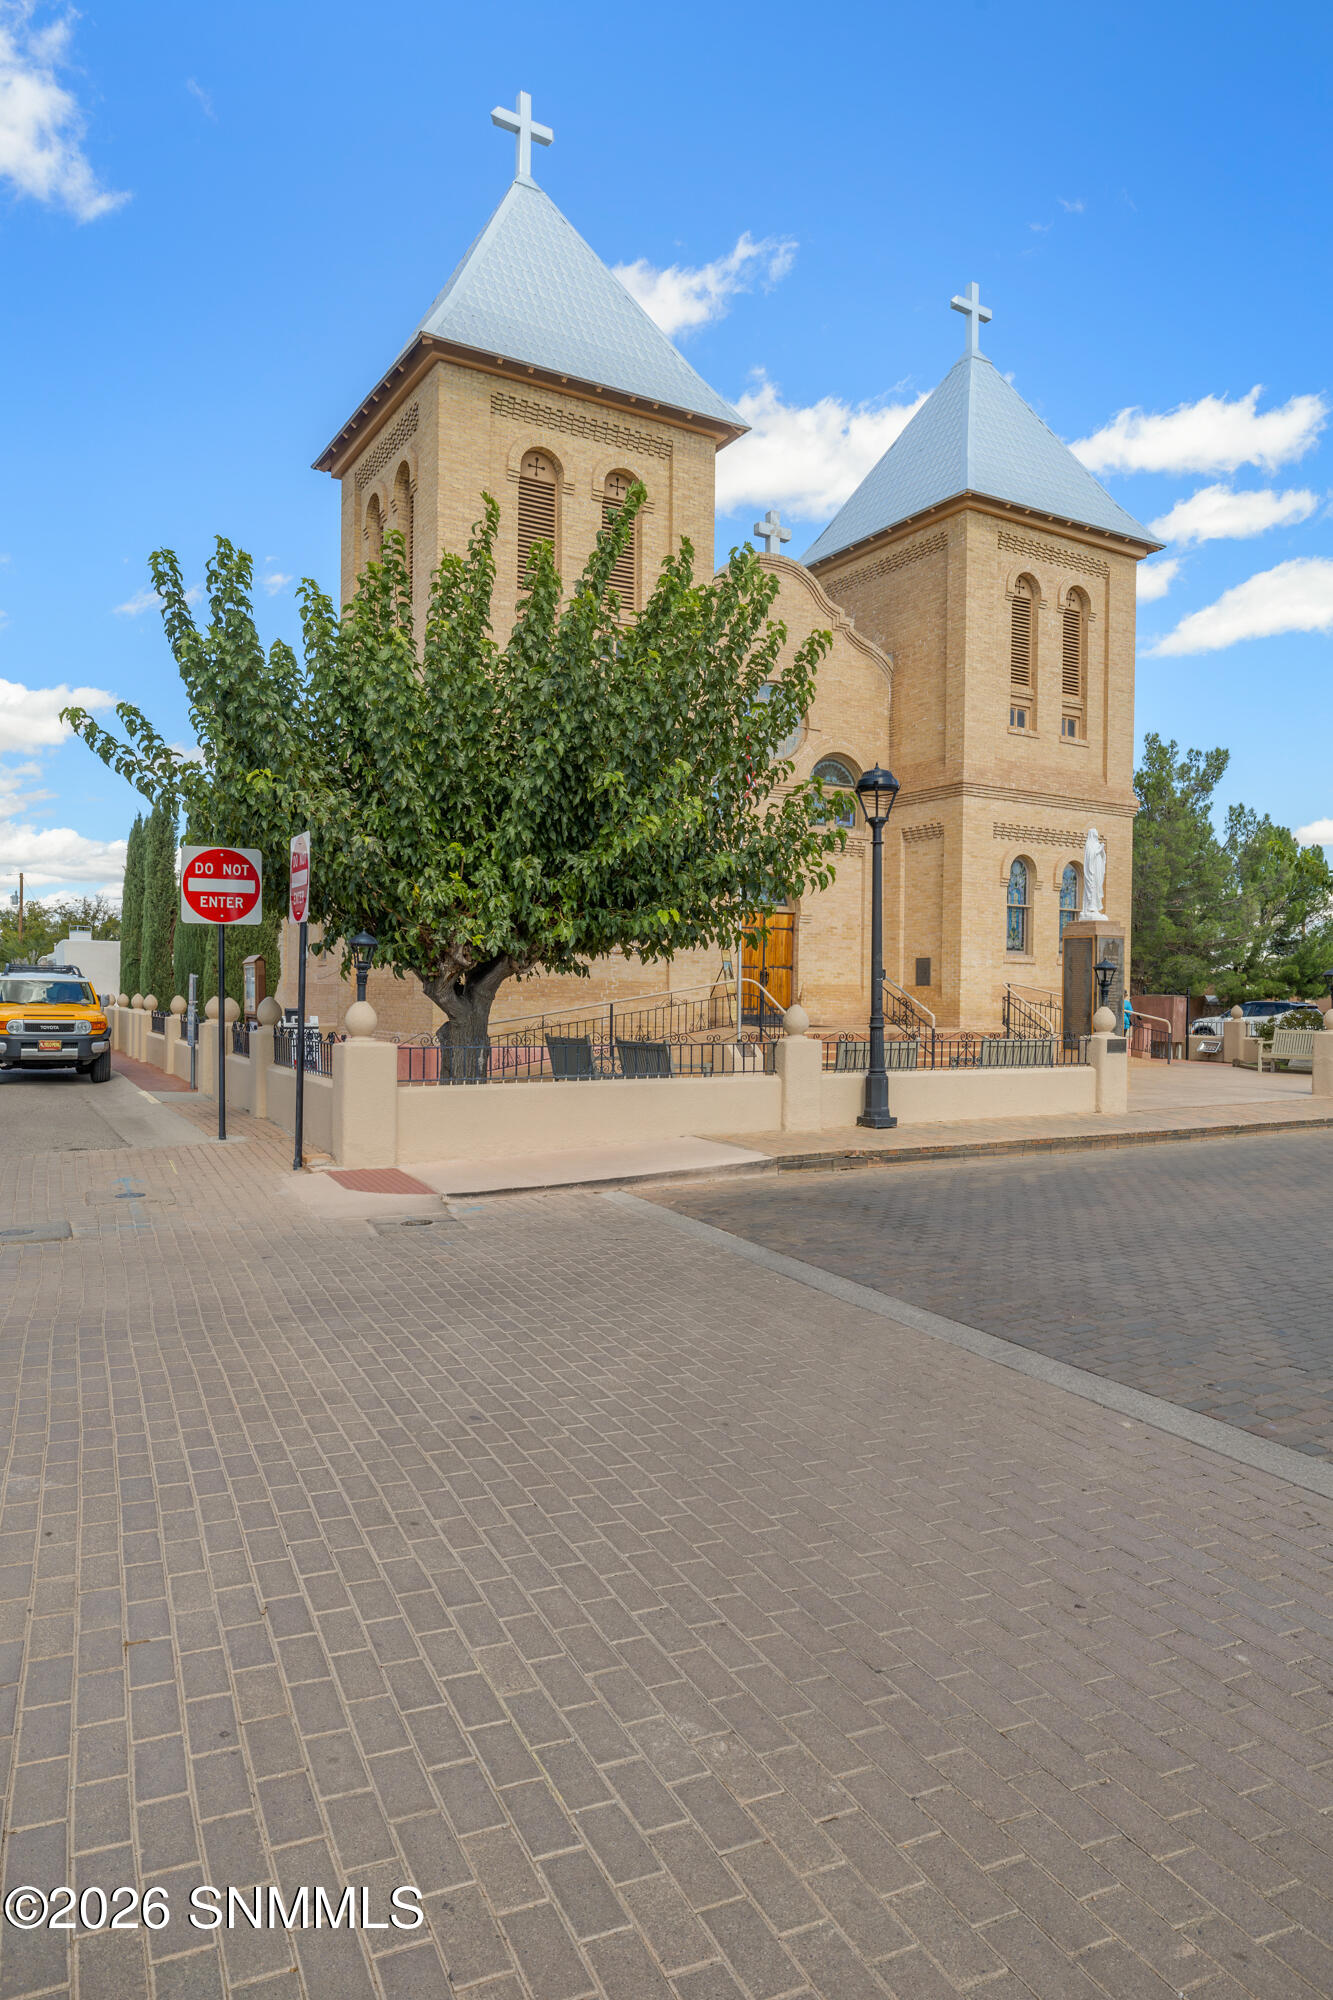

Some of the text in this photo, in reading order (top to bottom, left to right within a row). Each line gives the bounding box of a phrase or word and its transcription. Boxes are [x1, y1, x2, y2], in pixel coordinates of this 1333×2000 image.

[195, 862, 249, 876] DO NOT
[200, 896, 243, 909] ENTER
